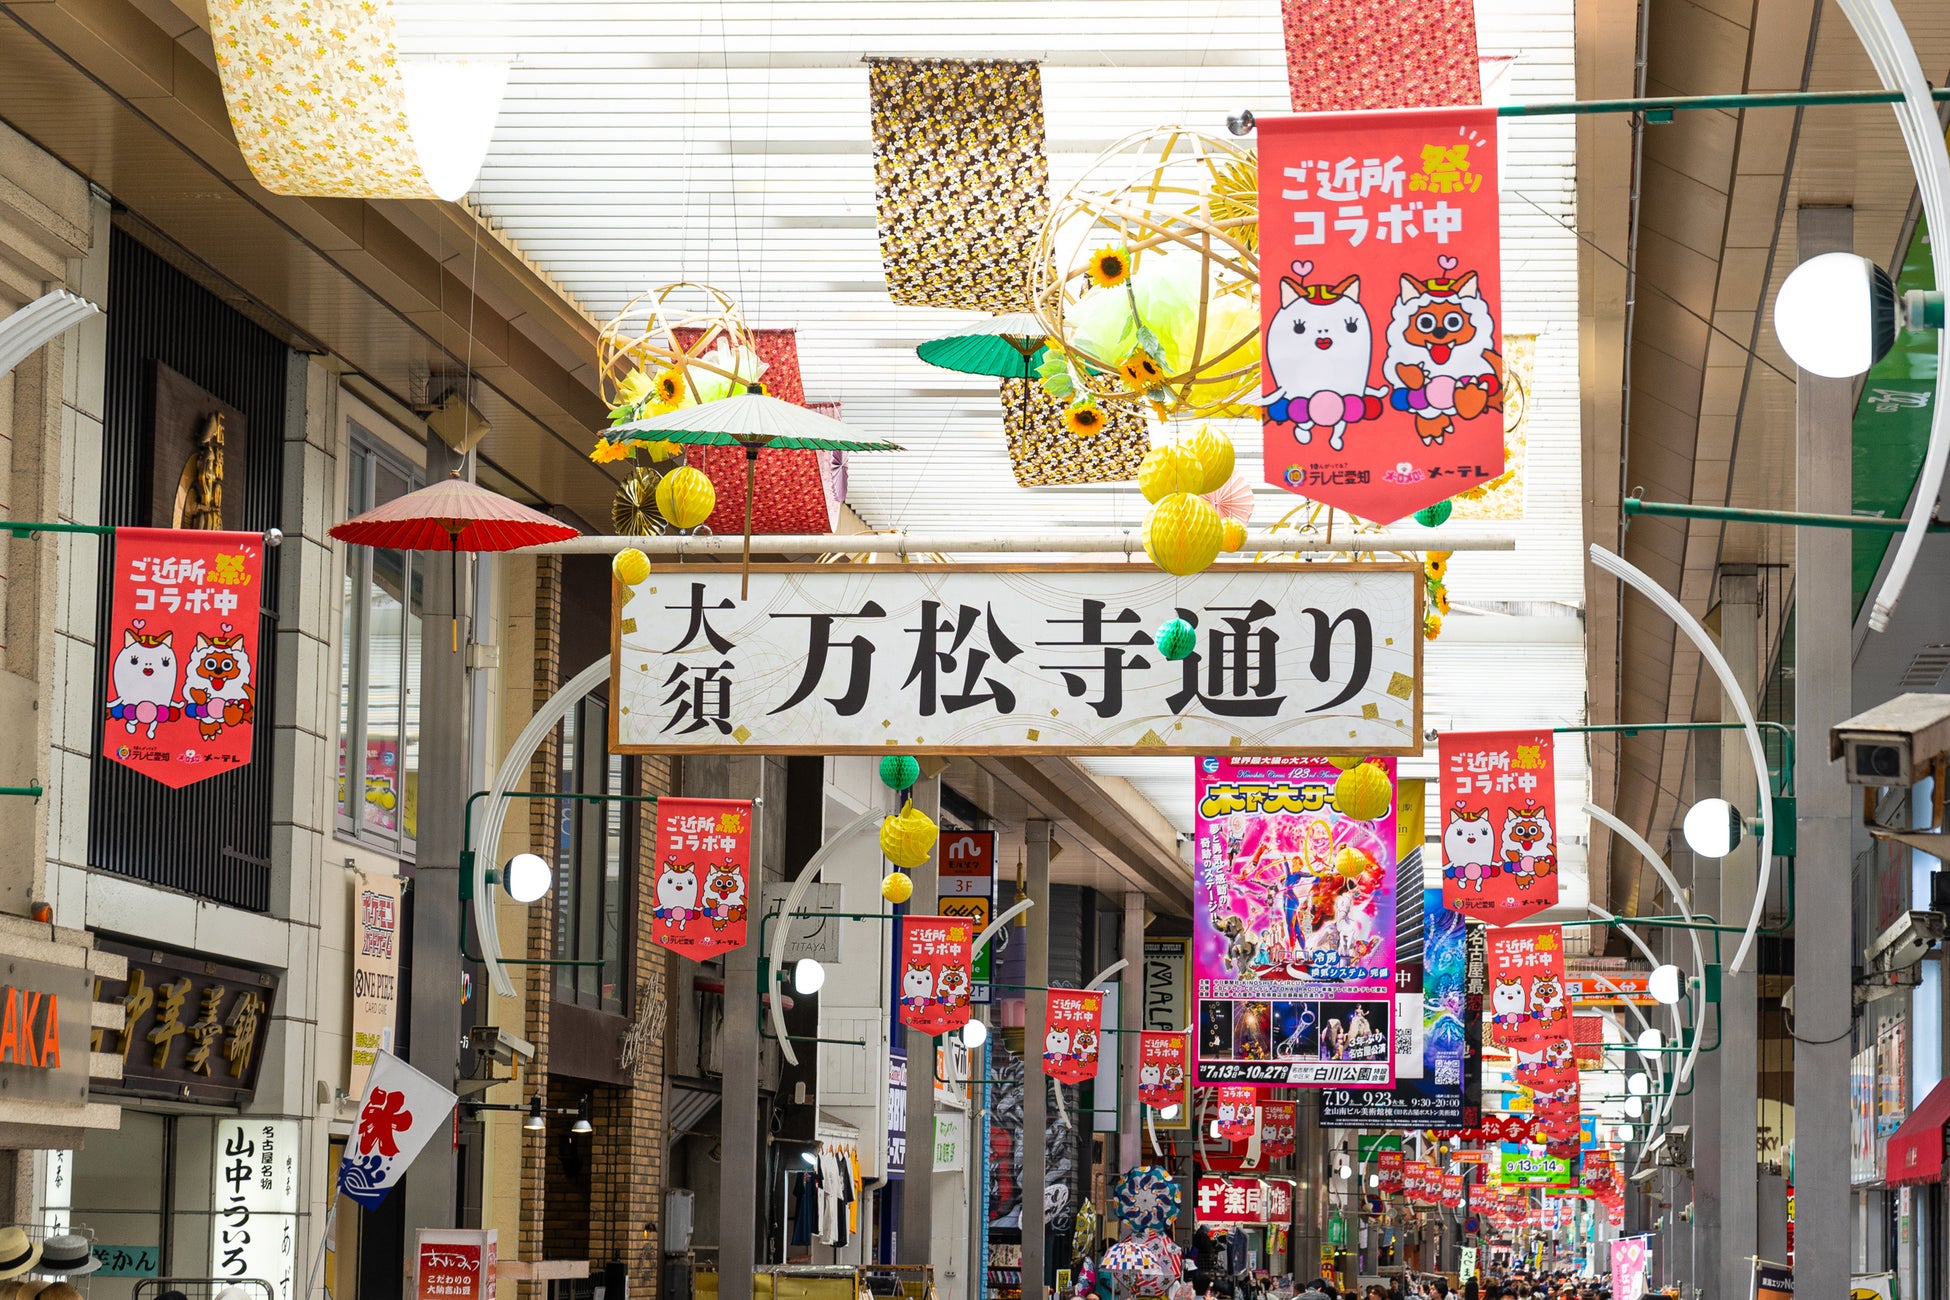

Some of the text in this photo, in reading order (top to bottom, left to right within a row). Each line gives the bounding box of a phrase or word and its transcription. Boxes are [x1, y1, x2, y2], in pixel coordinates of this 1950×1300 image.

[1293, 200, 1462, 247] コラボ中
[1309, 471, 1371, 486] テレビ愛知
[135, 587, 238, 616] コラボ中
[662, 582, 737, 736] 大須
[766, 599, 1374, 718] 万松寺通り
[1456, 772, 1537, 794] コラボ中
[670, 834, 736, 853] コラボ中
[955, 879, 973, 893] 3F
[912, 943, 961, 956] コラボ中
[1499, 952, 1553, 968] コラボ中
[355, 968, 375, 998] ONE
[970, 986, 985, 998] 2F
[365, 1001, 378, 1014] CARD
[1054, 1010, 1093, 1022] コラボ中
[0, 986, 61, 1069] AKA
[1146, 1048, 1179, 1058] コラボ中
[1314, 1067, 1372, 1081] 白川公園
[1322, 1091, 1350, 1107] 7.19
[1363, 1091, 1392, 1107] 9.23
[358, 1086, 413, 1157] 氷
[260, 1125, 274, 1190] 名古屋名物
[221, 1126, 255, 1276] 山中ういろ
[427, 1274, 471, 1284] こだわりの
